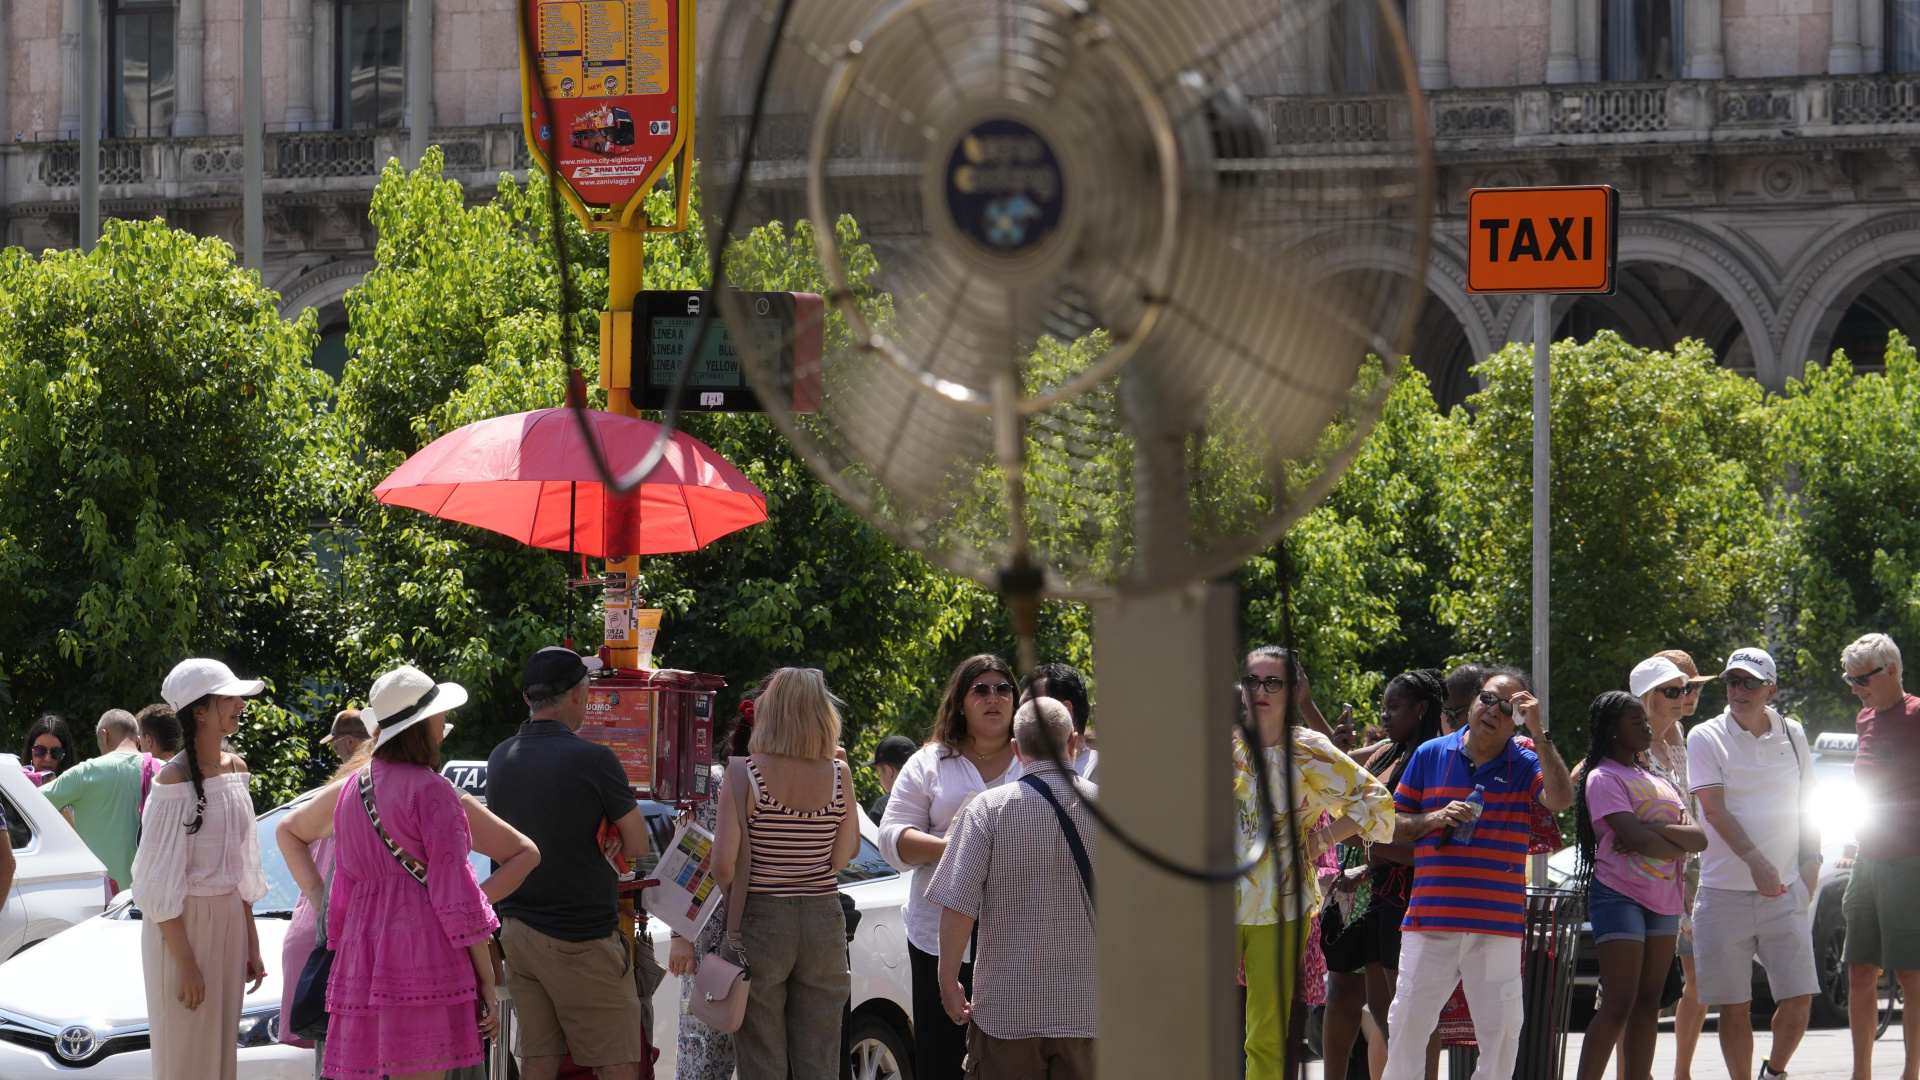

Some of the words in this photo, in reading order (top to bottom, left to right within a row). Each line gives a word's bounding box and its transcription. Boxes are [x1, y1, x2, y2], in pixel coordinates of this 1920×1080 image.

[588, 83, 602, 91] NEW
[560, 156, 652, 165] www.milano.city-sightseeing.it
[1480, 217, 1592, 262] TAXI
[653, 329, 676, 340] LINEA
[678, 329, 684, 340] A
[652, 344, 676, 355] LINEA
[678, 344, 683, 355] B
[652, 359, 675, 370] LINEA
[706, 361, 738, 372] YELLOW
[1822, 740, 1857, 749] TAXI
